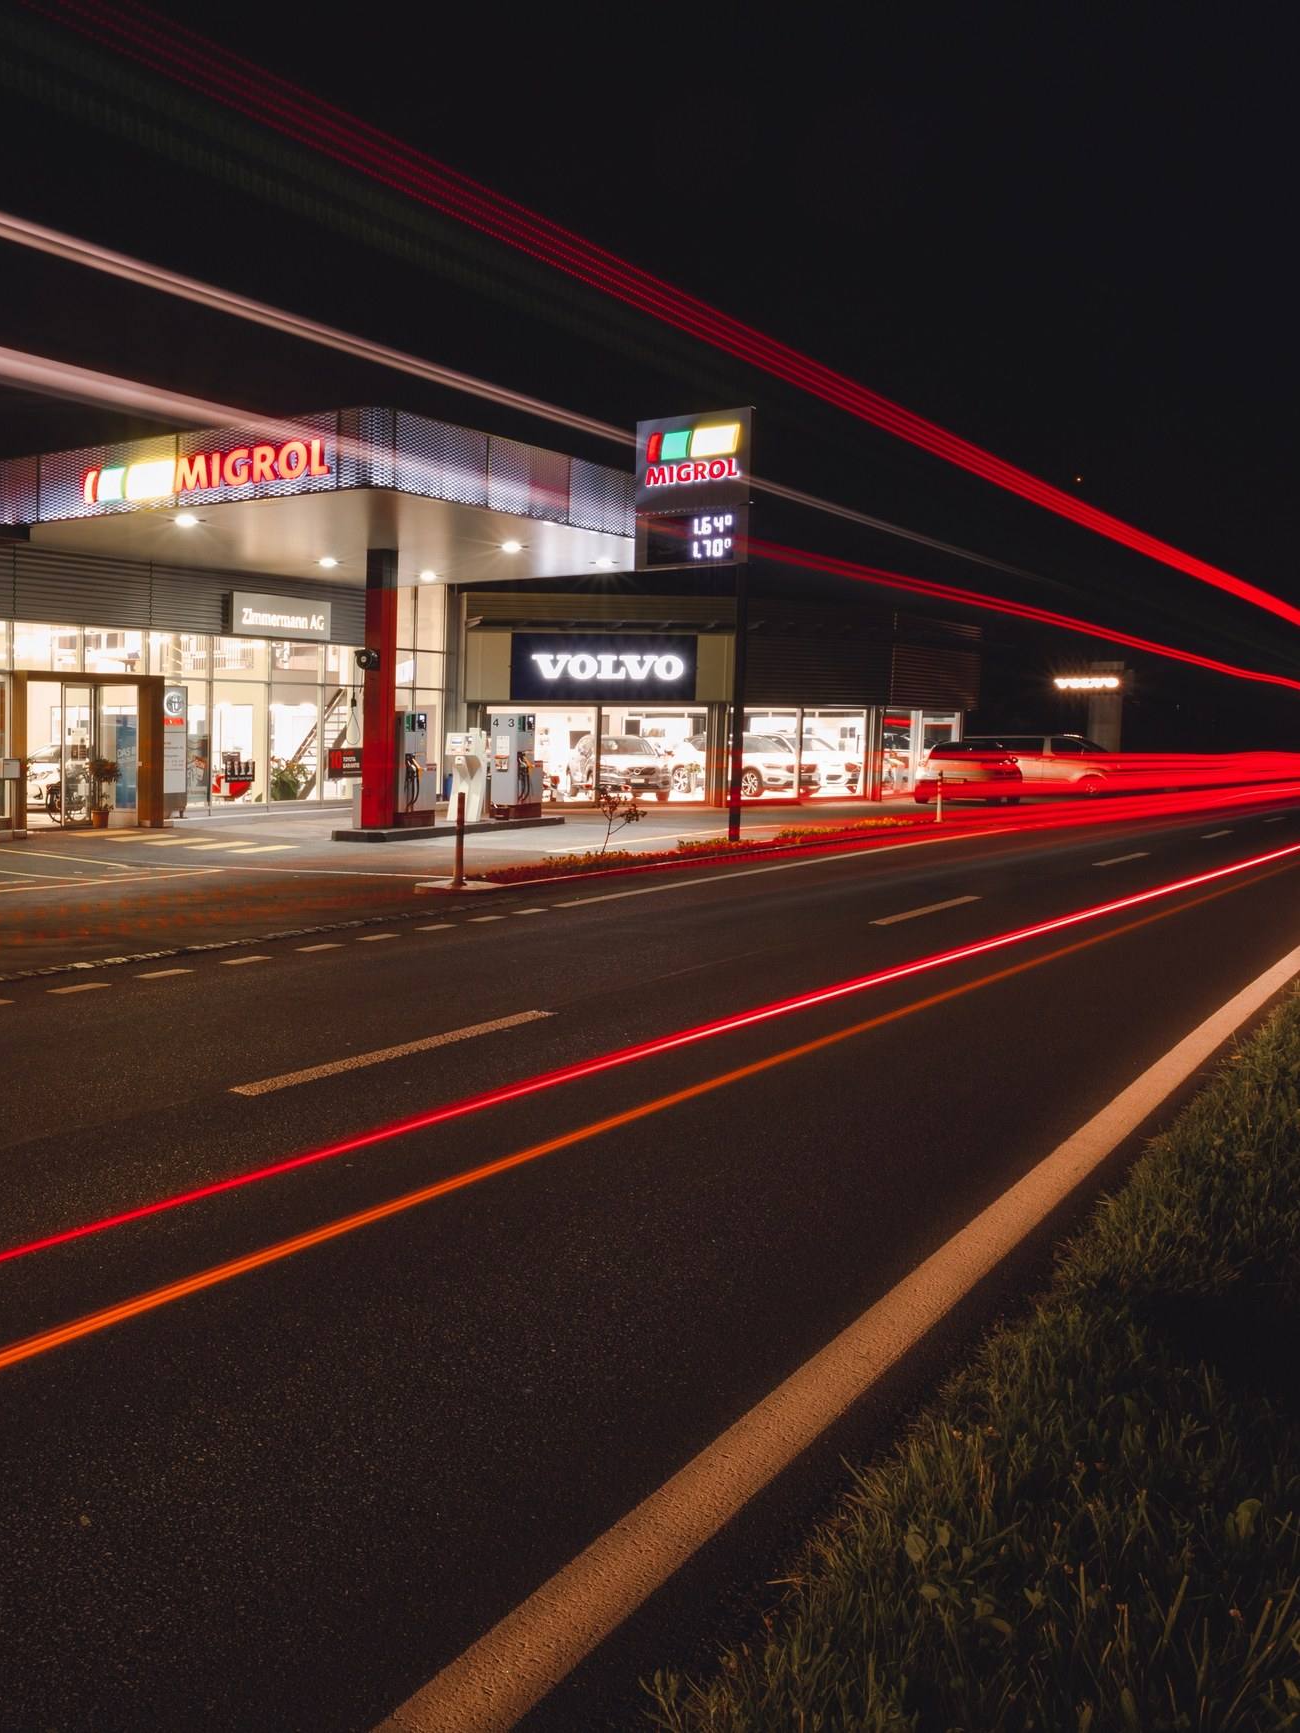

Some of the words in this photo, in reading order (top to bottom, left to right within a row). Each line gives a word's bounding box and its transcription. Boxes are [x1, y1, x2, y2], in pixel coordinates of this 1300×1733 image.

[174, 438, 330, 492] MIGROL
[645, 457, 741, 488] MIGROL
[241, 607, 309, 630] Zimmermann
[309, 614, 325, 631] AG
[531, 653, 685, 682] VOLVO
[493, 718, 500, 727] 4
[508, 718, 515, 727] 3
[331, 750, 342, 769] 10
